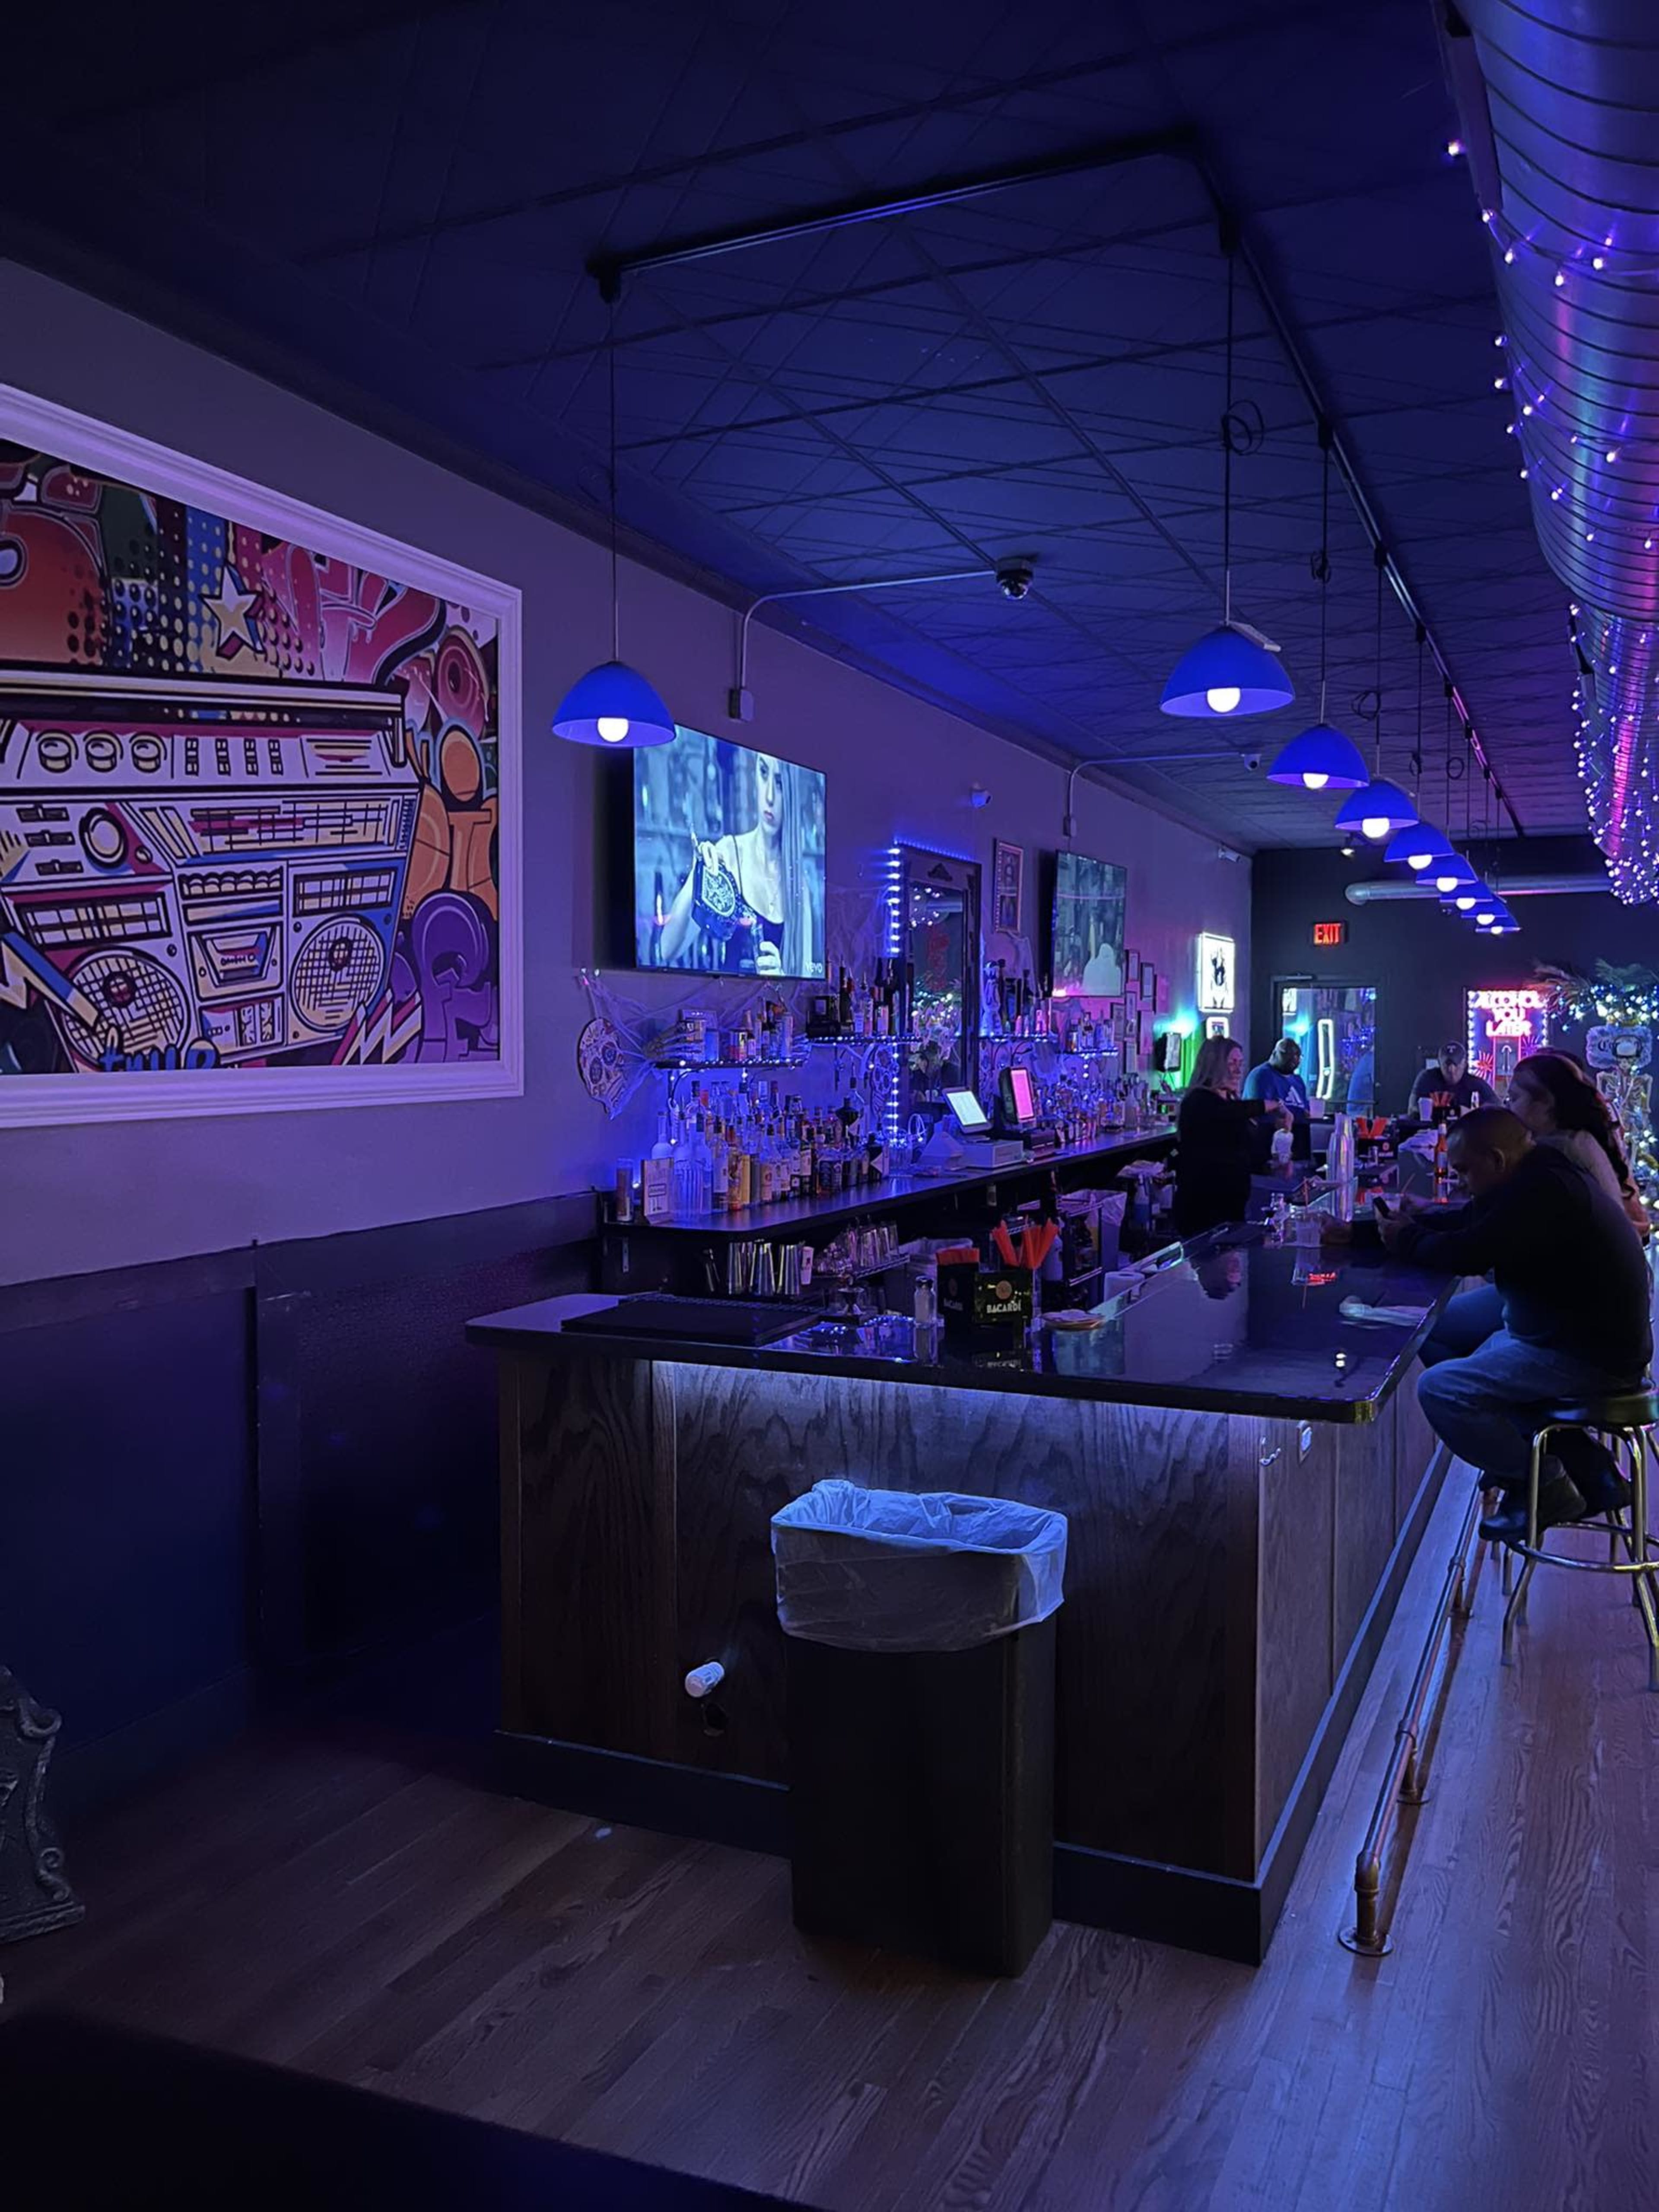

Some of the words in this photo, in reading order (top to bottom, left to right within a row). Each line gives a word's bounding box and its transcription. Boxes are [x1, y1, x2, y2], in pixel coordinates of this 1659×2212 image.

[1314, 923, 1341, 944] EXIT
[1474, 990, 1546, 1009] ALCOHOL
[1492, 1007, 1526, 1022] YOU
[1486, 1019, 1532, 1037] LATER
